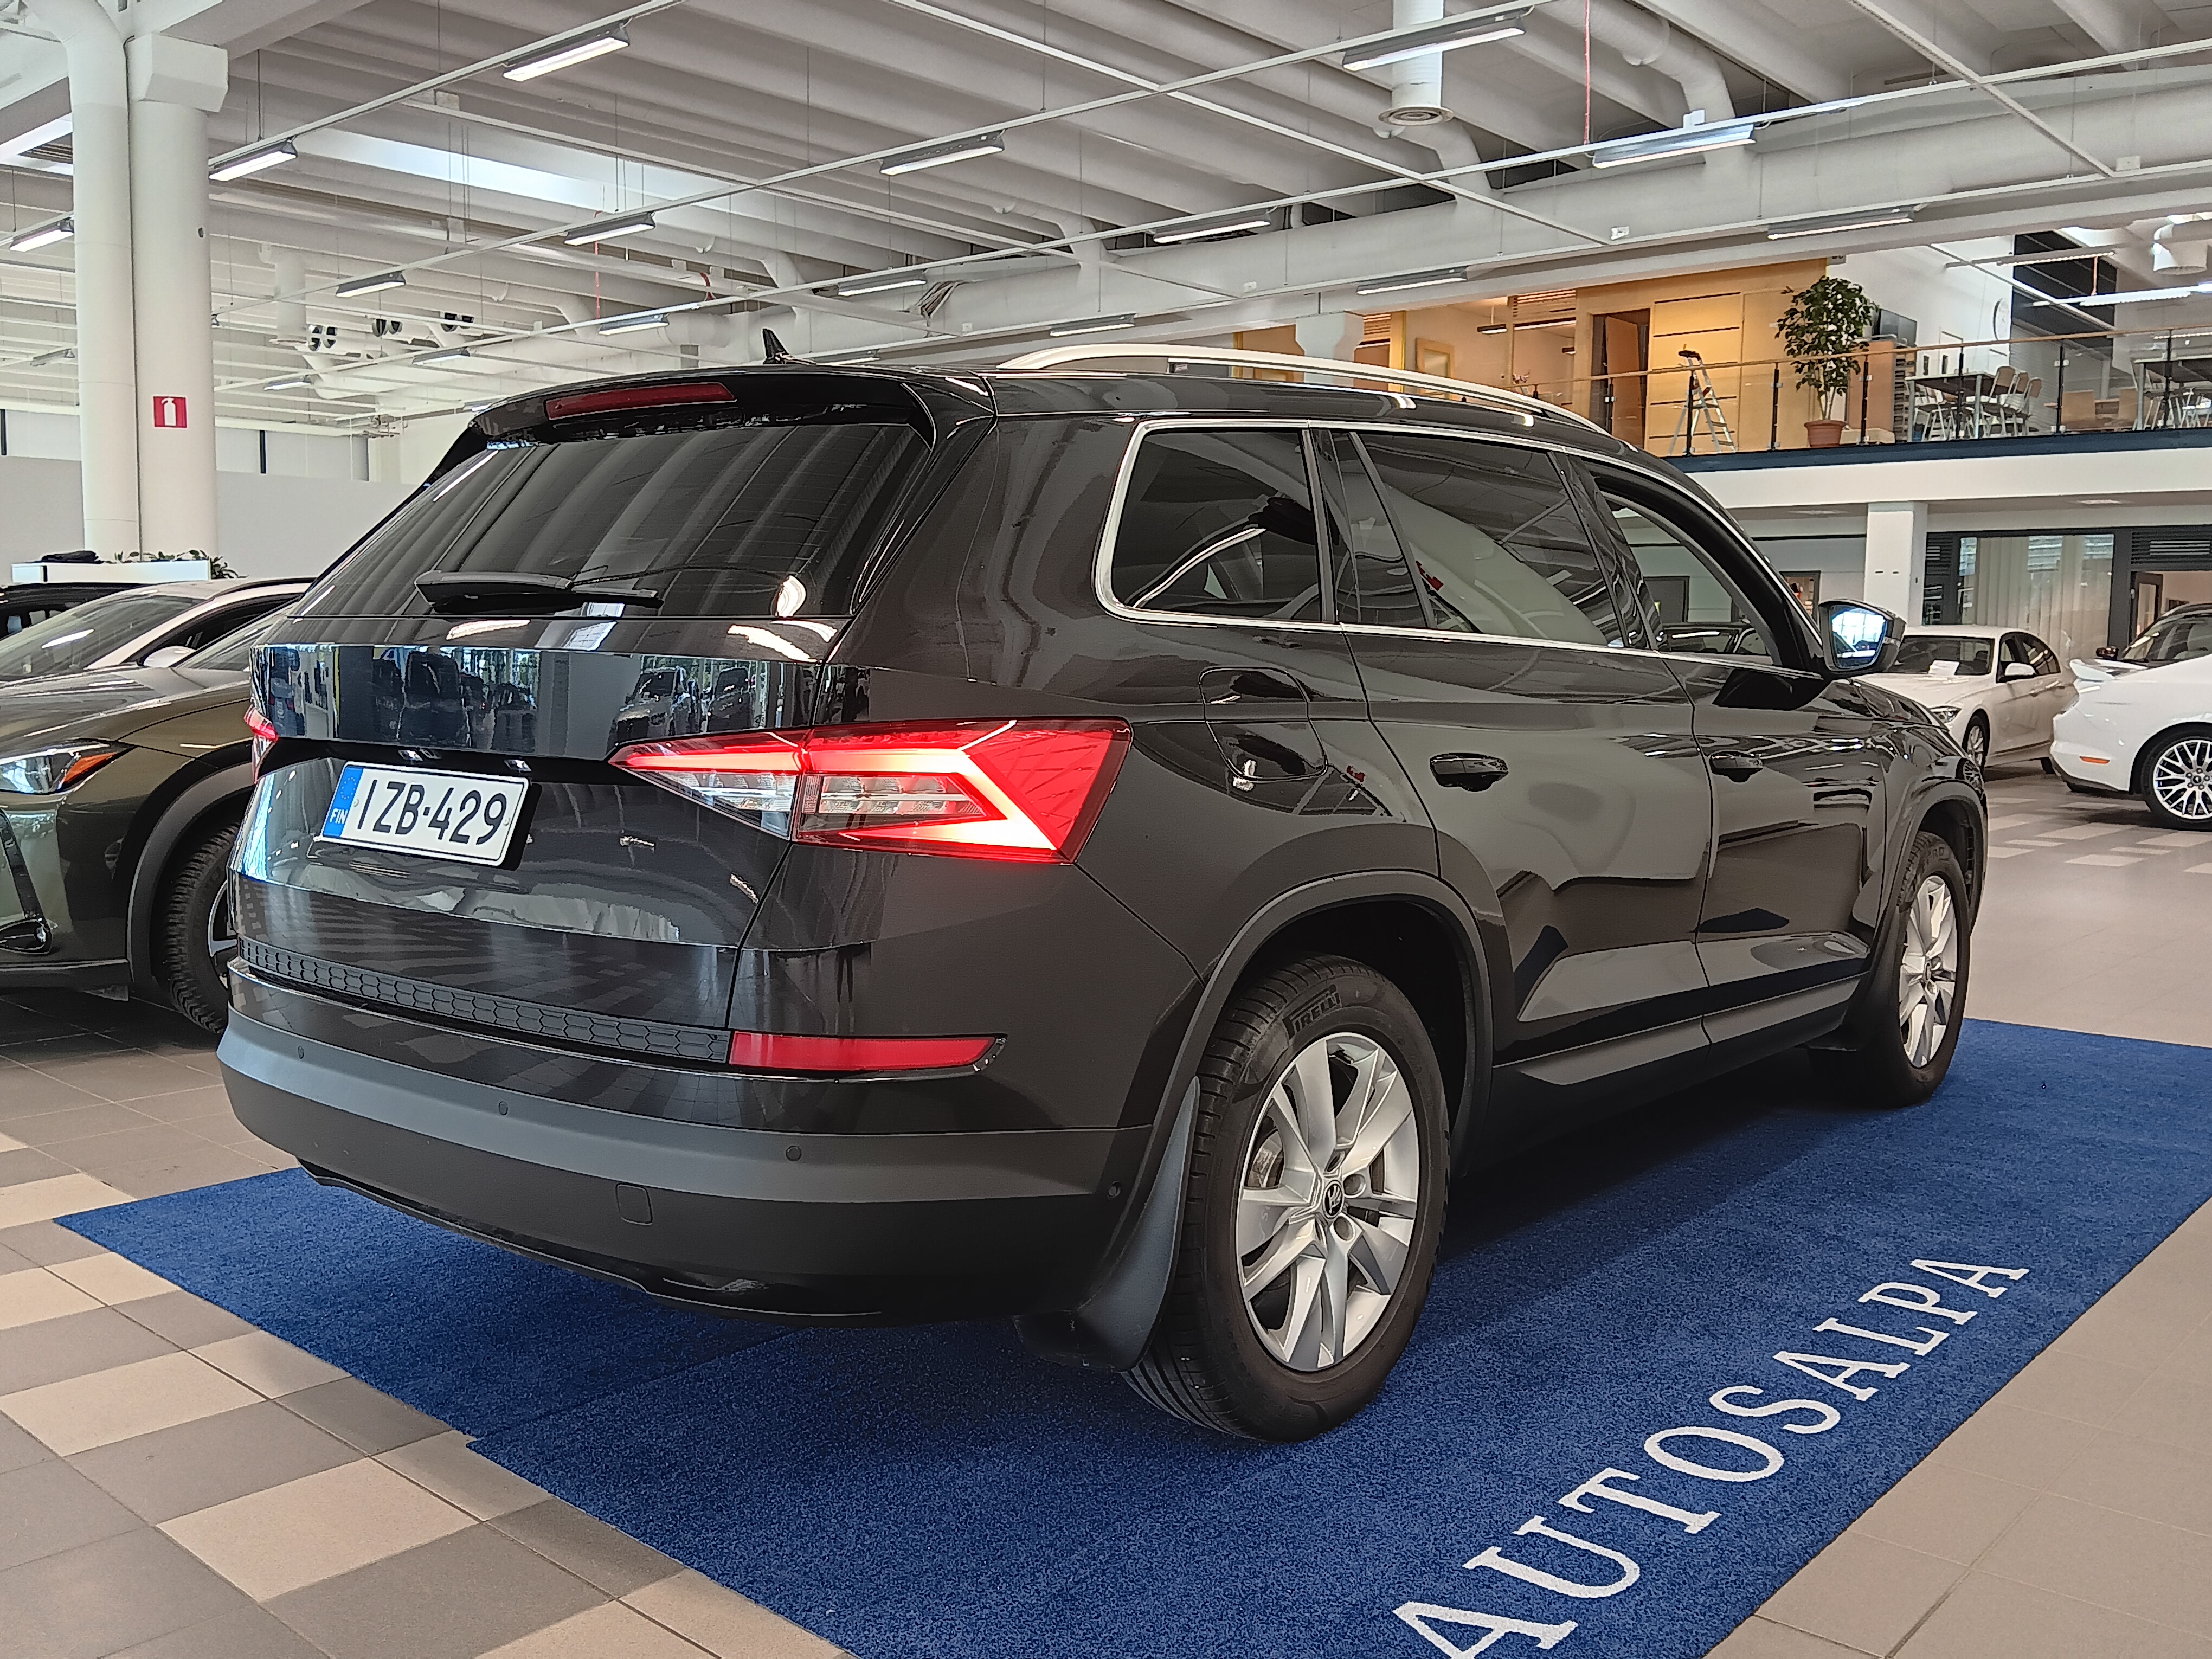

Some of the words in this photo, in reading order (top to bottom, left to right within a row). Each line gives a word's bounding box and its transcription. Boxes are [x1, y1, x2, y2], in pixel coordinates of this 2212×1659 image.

[329, 808, 349, 825] FIN
[357, 780, 507, 845] IZB-429
[1282, 983, 1341, 1040] PIRELLI
[1392, 1259, 2030, 1659] AUTOSALPA
